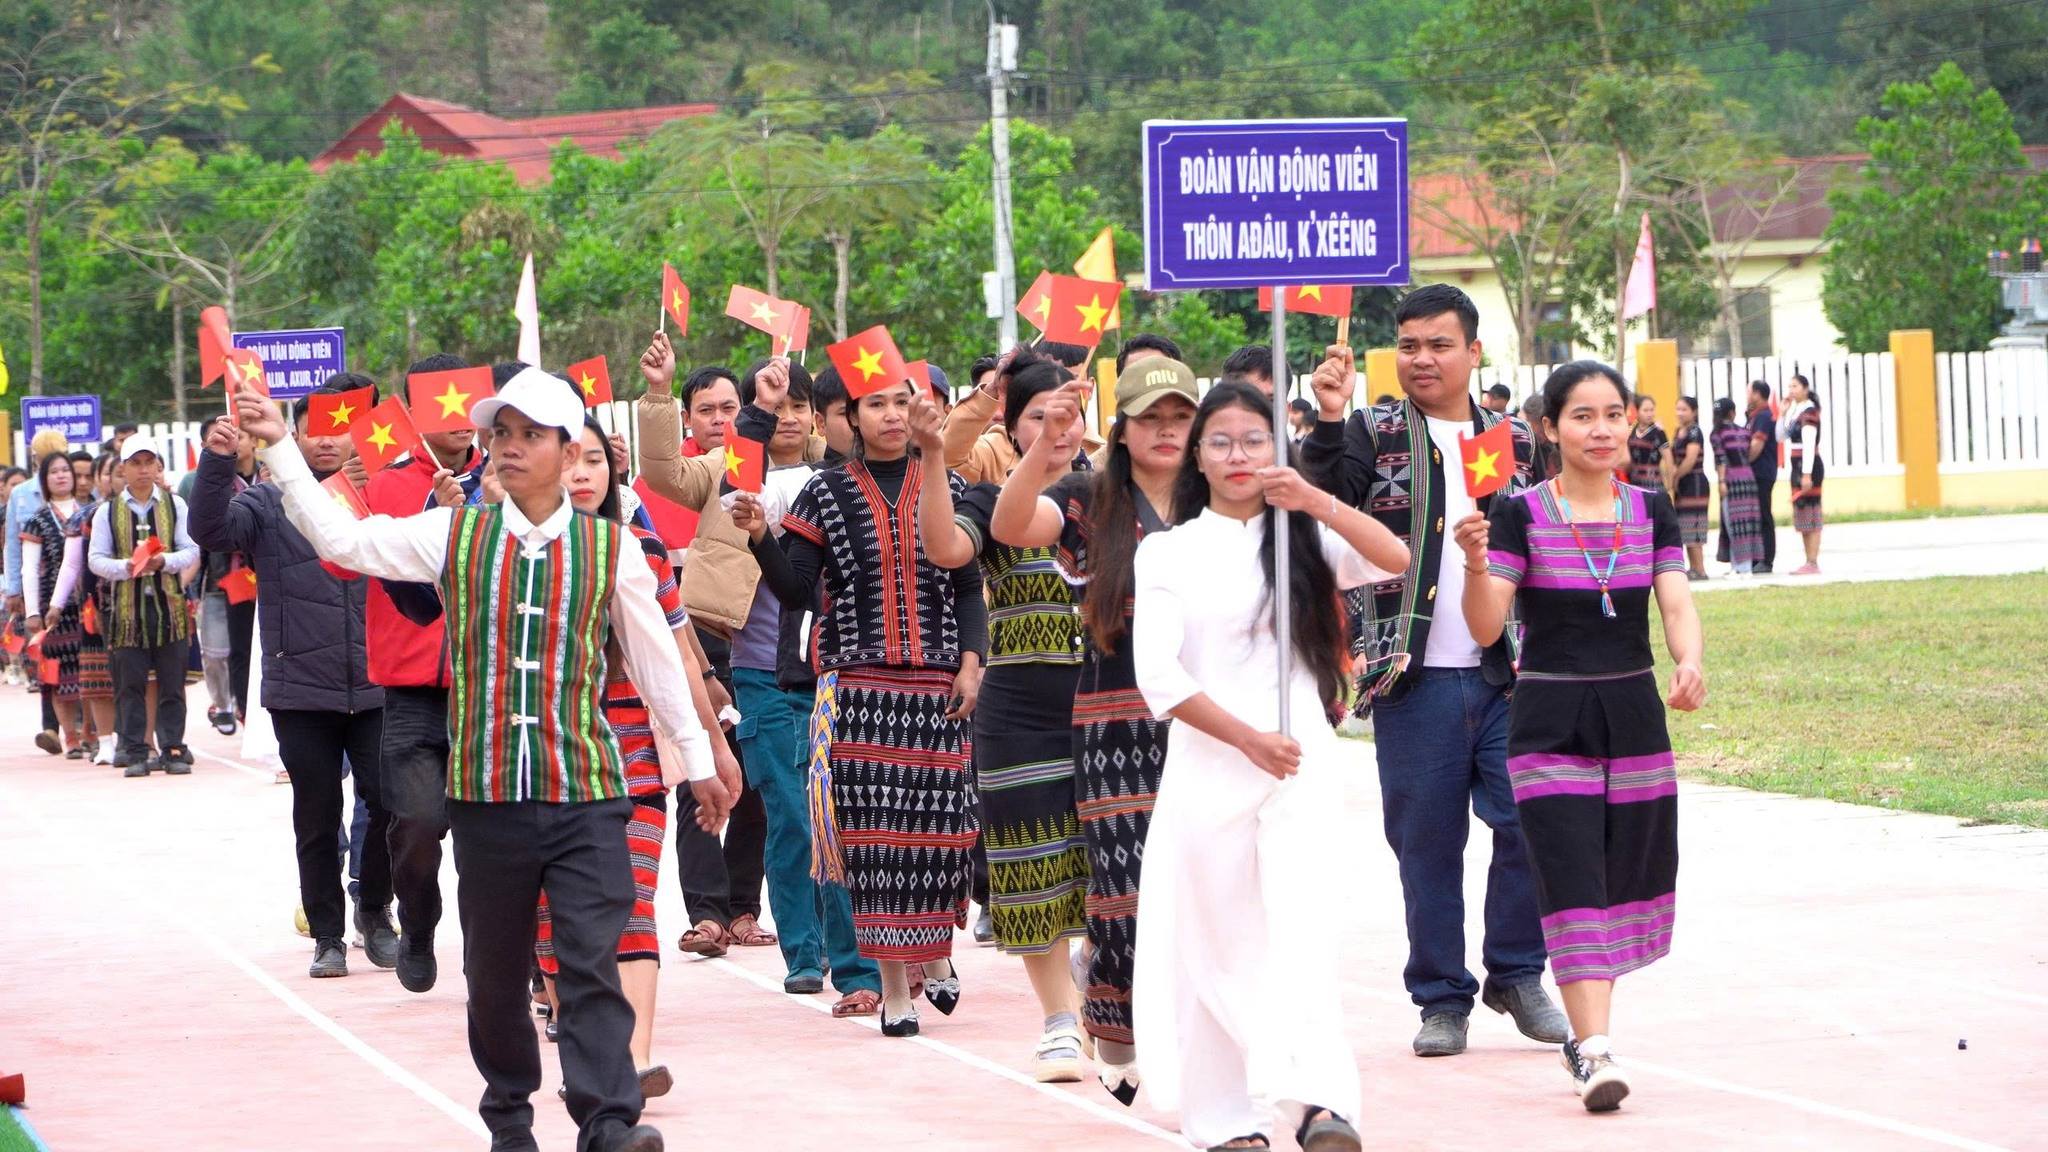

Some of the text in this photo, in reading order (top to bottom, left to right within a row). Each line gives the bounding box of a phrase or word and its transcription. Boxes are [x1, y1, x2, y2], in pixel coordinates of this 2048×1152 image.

[1180, 145, 1378, 202] ĐOÀN VẬN ĐỘNG VIÊN
[1183, 210, 1377, 263] THÔN AĐÂU, K'XÊÊNG
[270, 341, 287, 364] VẬN
[288, 340, 311, 363] ĐỘNG
[312, 339, 332, 359] VIÊN
